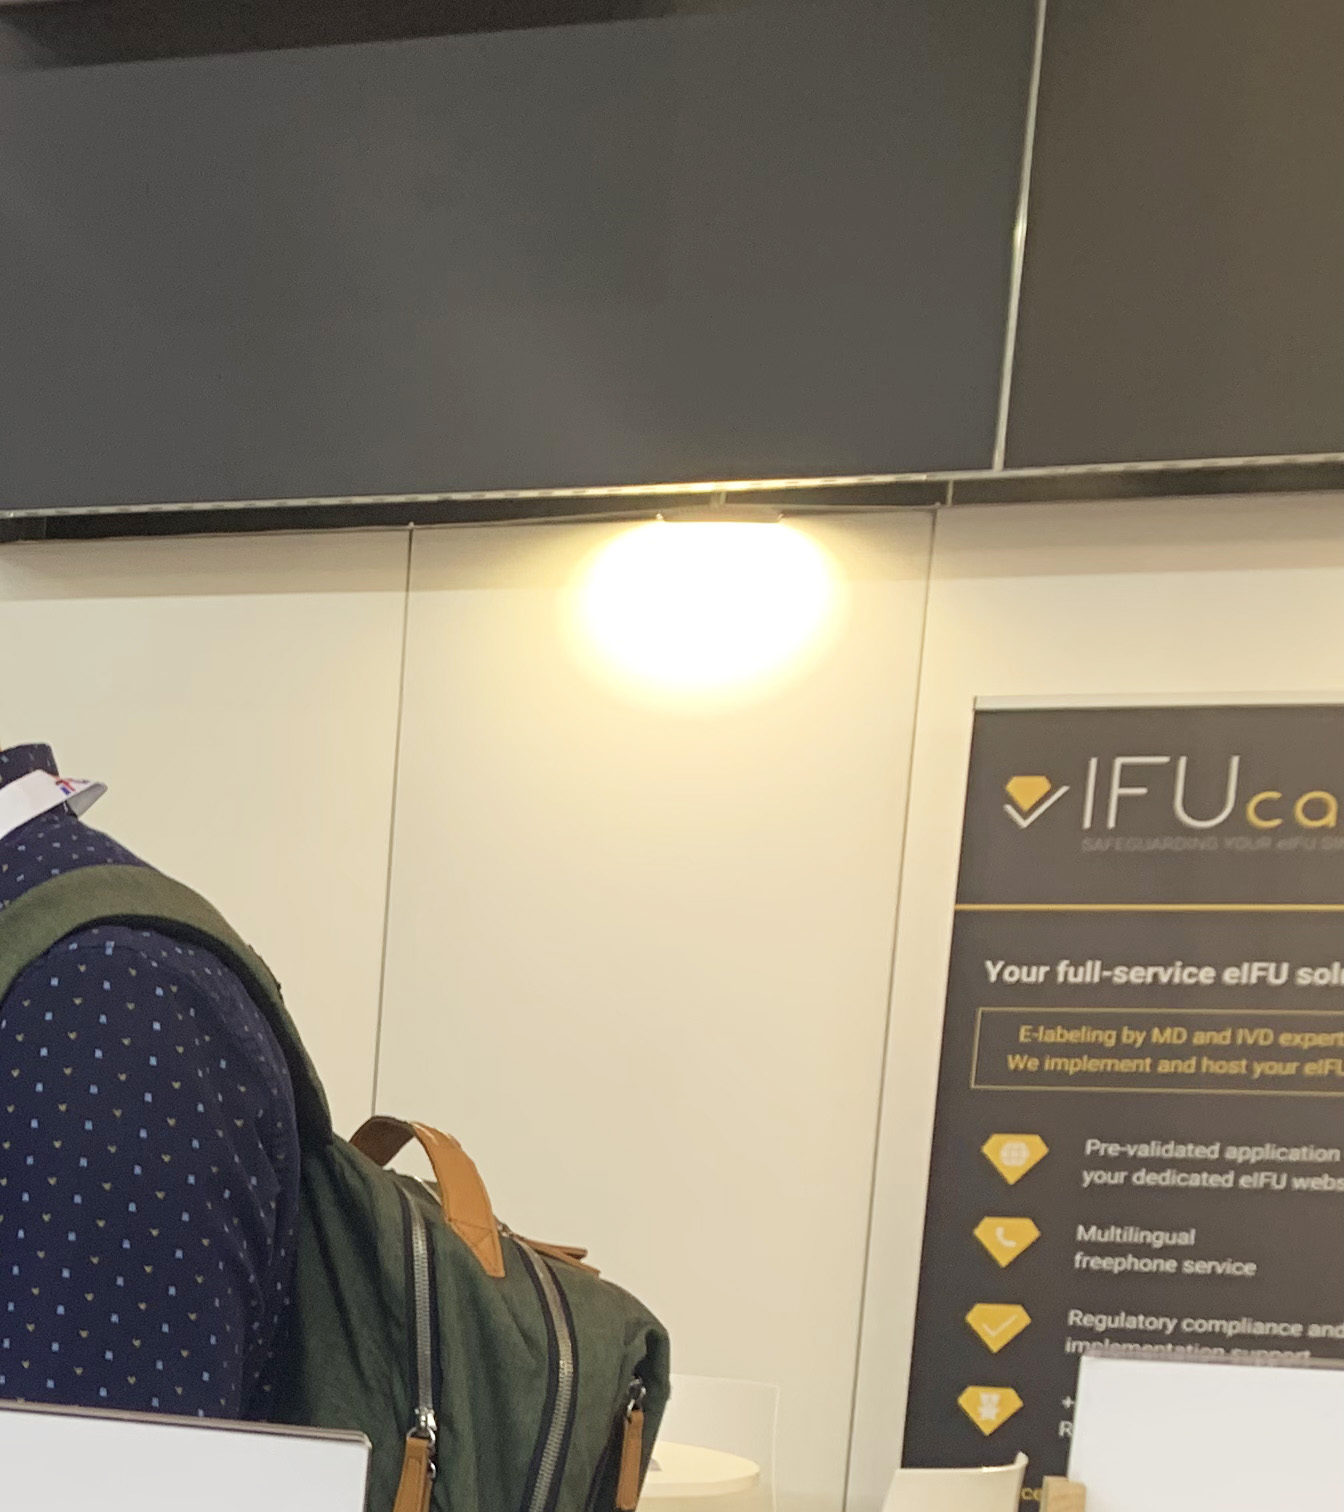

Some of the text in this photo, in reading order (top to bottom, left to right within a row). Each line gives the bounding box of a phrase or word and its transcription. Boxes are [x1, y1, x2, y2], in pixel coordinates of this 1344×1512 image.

[984, 959, 1051, 985] Your
[1055, 959, 1216, 986] full-service
[1222, 962, 1289, 986] eIFU
[1018, 1025, 1117, 1048] E-labeling
[1121, 1026, 1147, 1048] by
[1150, 1027, 1188, 1045] MD
[1193, 1027, 1232, 1046] and
[1236, 1028, 1274, 1047] IVD
[1007, 1053, 1040, 1072] We
[1043, 1054, 1152, 1076] implement
[1156, 1055, 1197, 1074] and
[1200, 1055, 1247, 1075] host
[1251, 1058, 1300, 1079] your
[1084, 1138, 1341, 1164] Pre-validated application
[1081, 1168, 1129, 1188] your
[1131, 1167, 1235, 1189] dedicated
[1238, 1171, 1288, 1190] eIFU
[1075, 1223, 1197, 1249] Multilingual
[1073, 1251, 1258, 1277] freephone service
[1067, 1308, 1179, 1335] Regulatory
[1180, 1316, 1304, 1338] compliance
